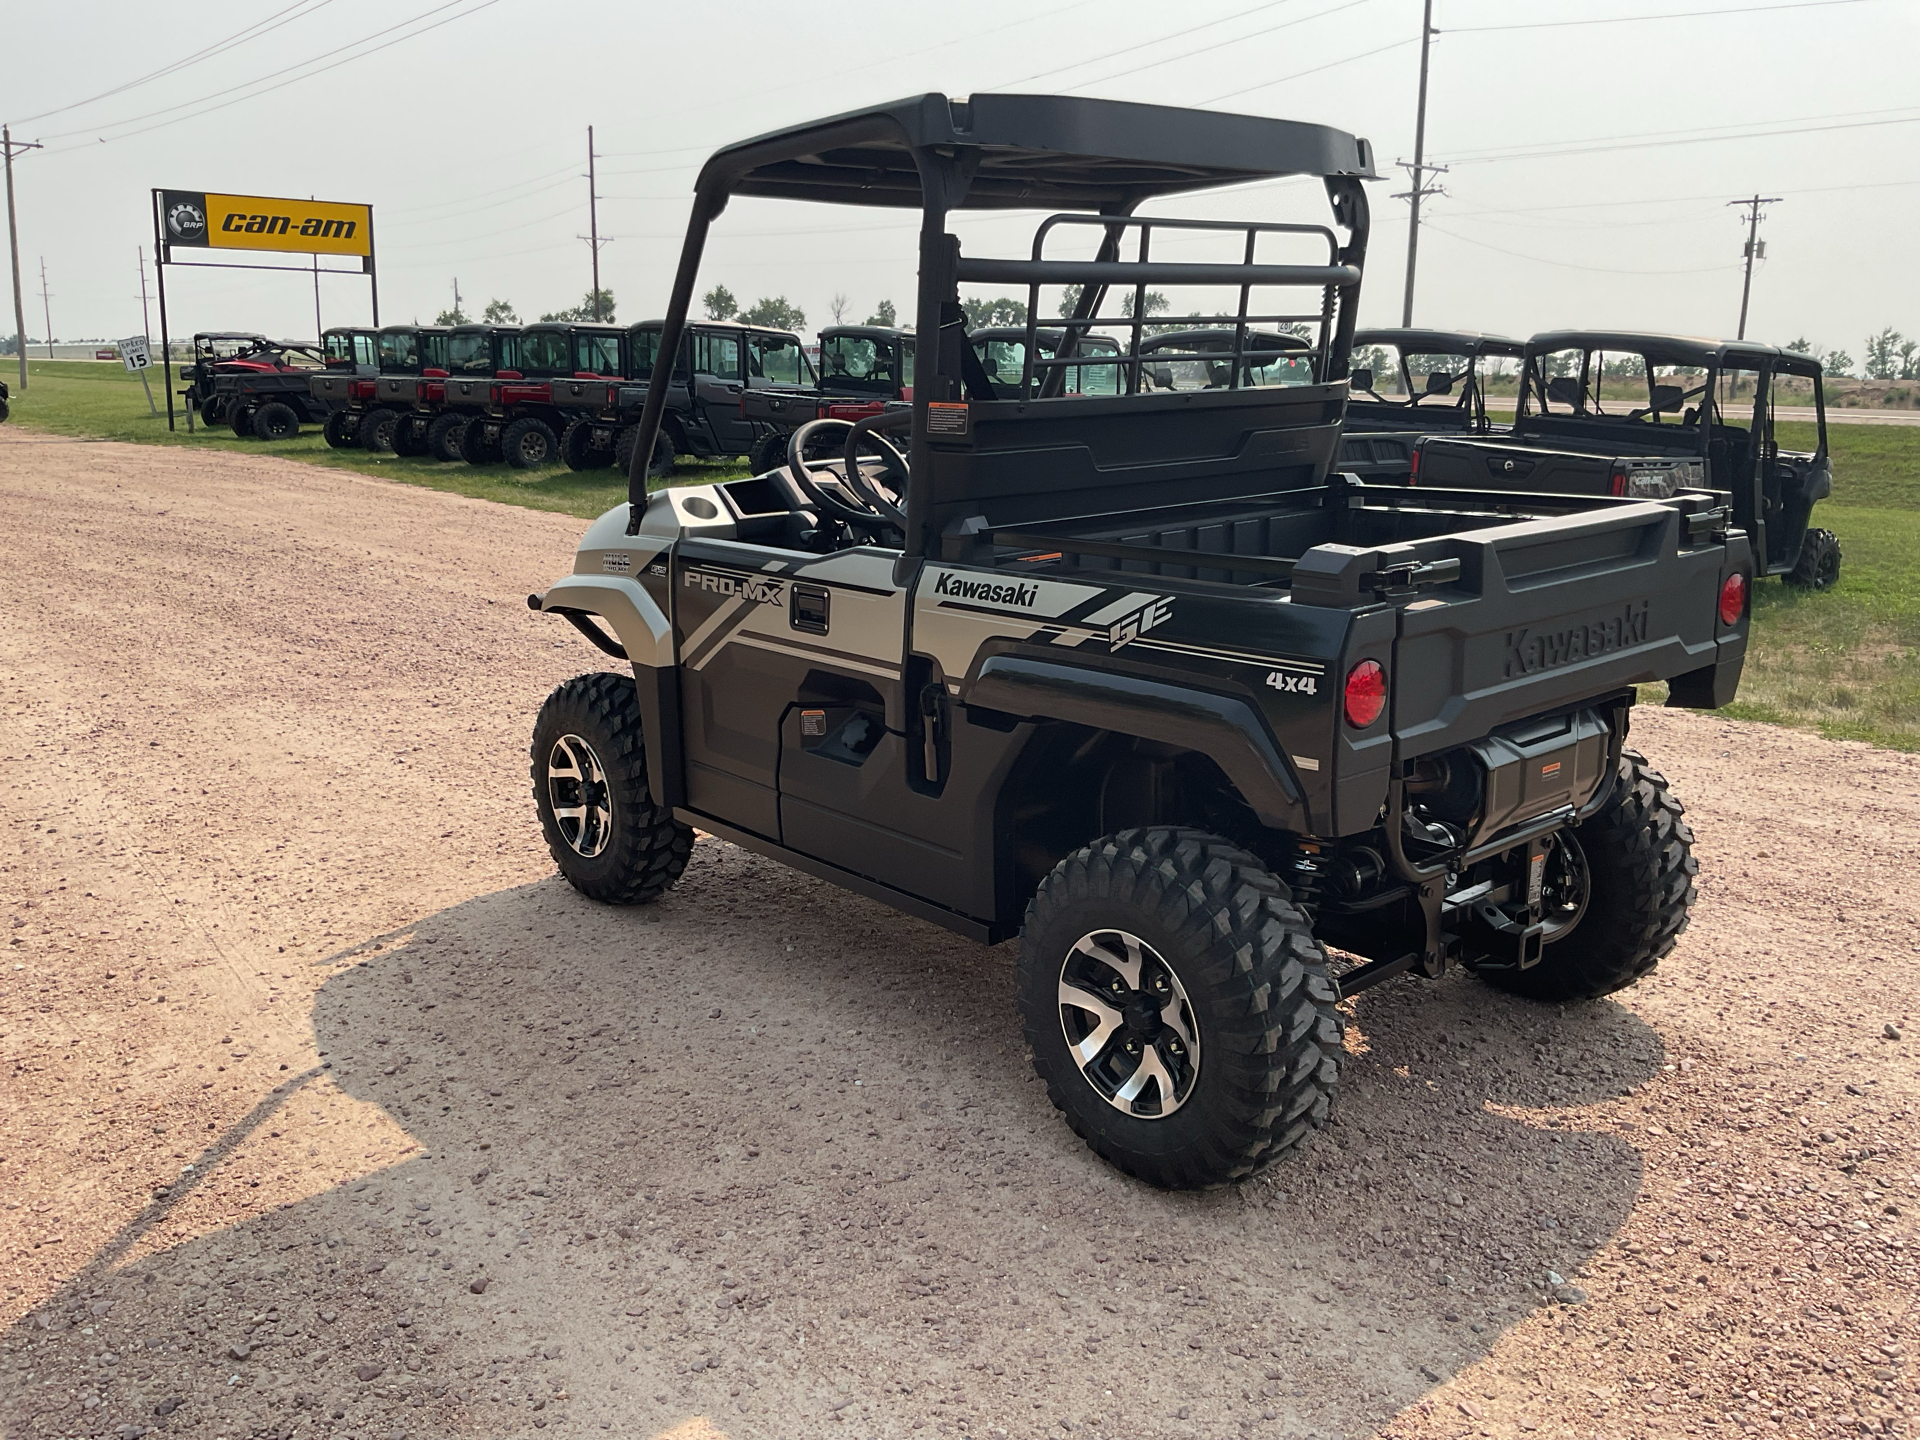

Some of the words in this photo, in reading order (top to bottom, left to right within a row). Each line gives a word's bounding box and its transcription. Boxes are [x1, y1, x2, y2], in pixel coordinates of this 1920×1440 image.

[183, 221, 203, 229] BRP
[221, 213, 355, 239] can-am
[121, 340, 145, 349] SPEED
[126, 346, 143, 355] LIMIT
[129, 354, 147, 368] 15
[684, 571, 784, 607] PRO-MX
[934, 572, 1039, 608] Kawasaki
[1503, 600, 1650, 678] Kawasaki
[1265, 671, 1318, 696] 4x4
